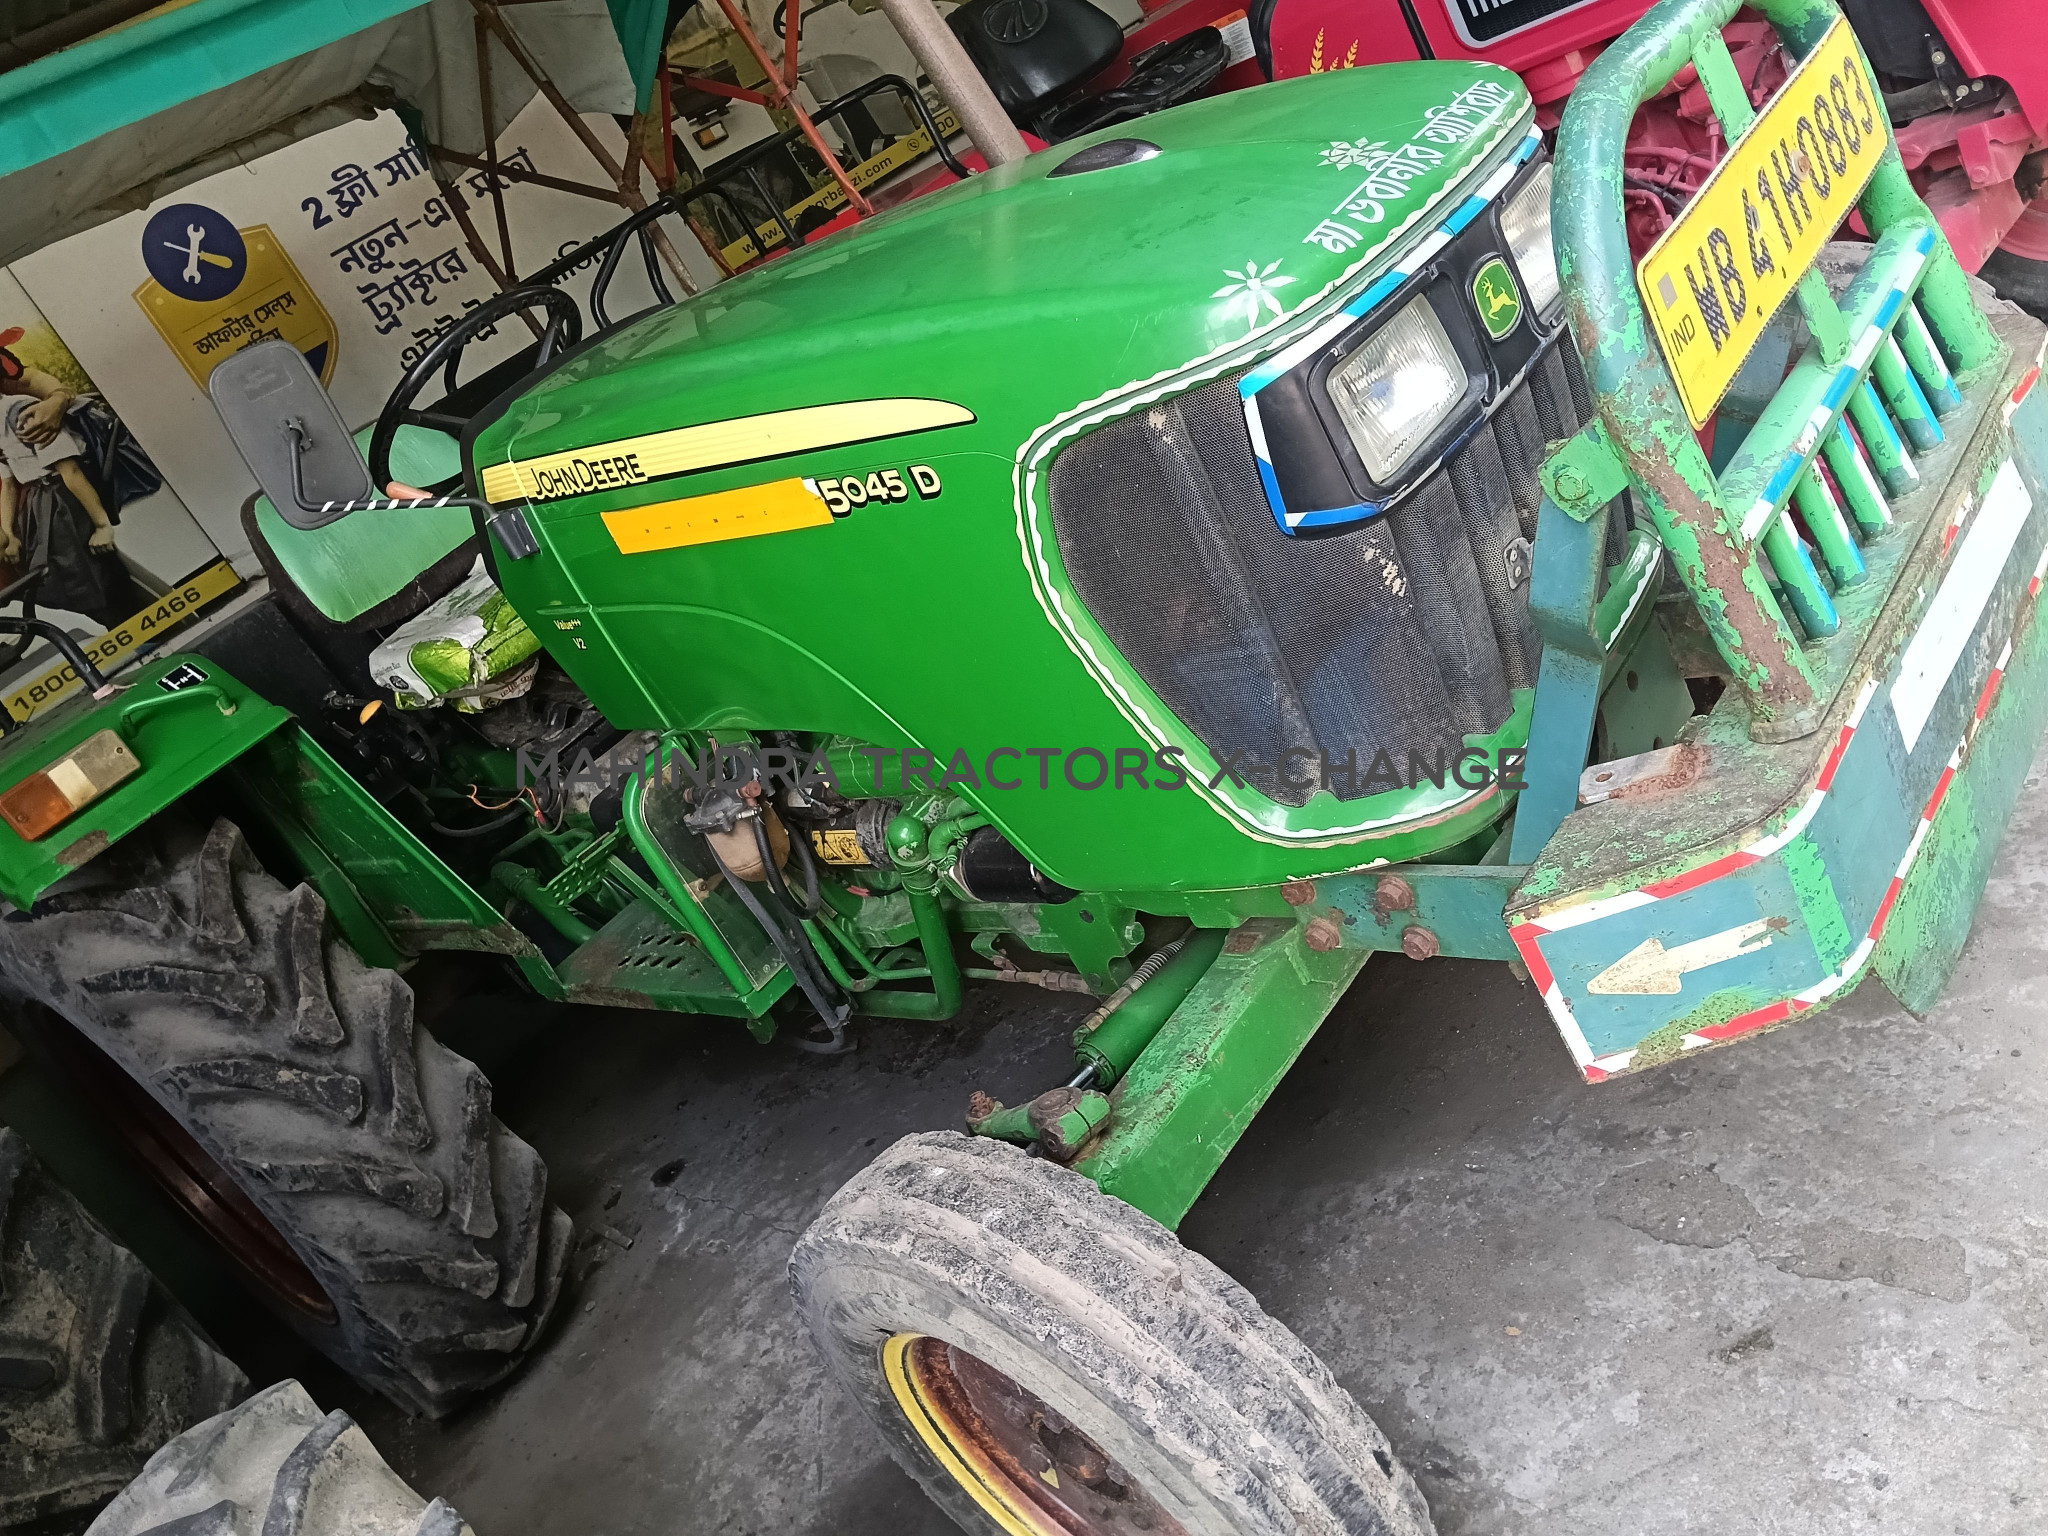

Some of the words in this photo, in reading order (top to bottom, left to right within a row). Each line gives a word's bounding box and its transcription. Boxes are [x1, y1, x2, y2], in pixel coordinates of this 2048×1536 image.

[301, 197, 333, 230] 2
[1302, 218, 1363, 253] মা
[193, 314, 255, 354] আফটার
[1670, 314, 1695, 356] IND
[572, 453, 646, 488] DEERE
[816, 469, 909, 517] 5045
[907, 464, 942, 500] D
[14, 665, 79, 711] 1800
[87, 629, 134, 668] 266
[140, 587, 201, 633] 4466
[572, 637, 588, 650] V2
